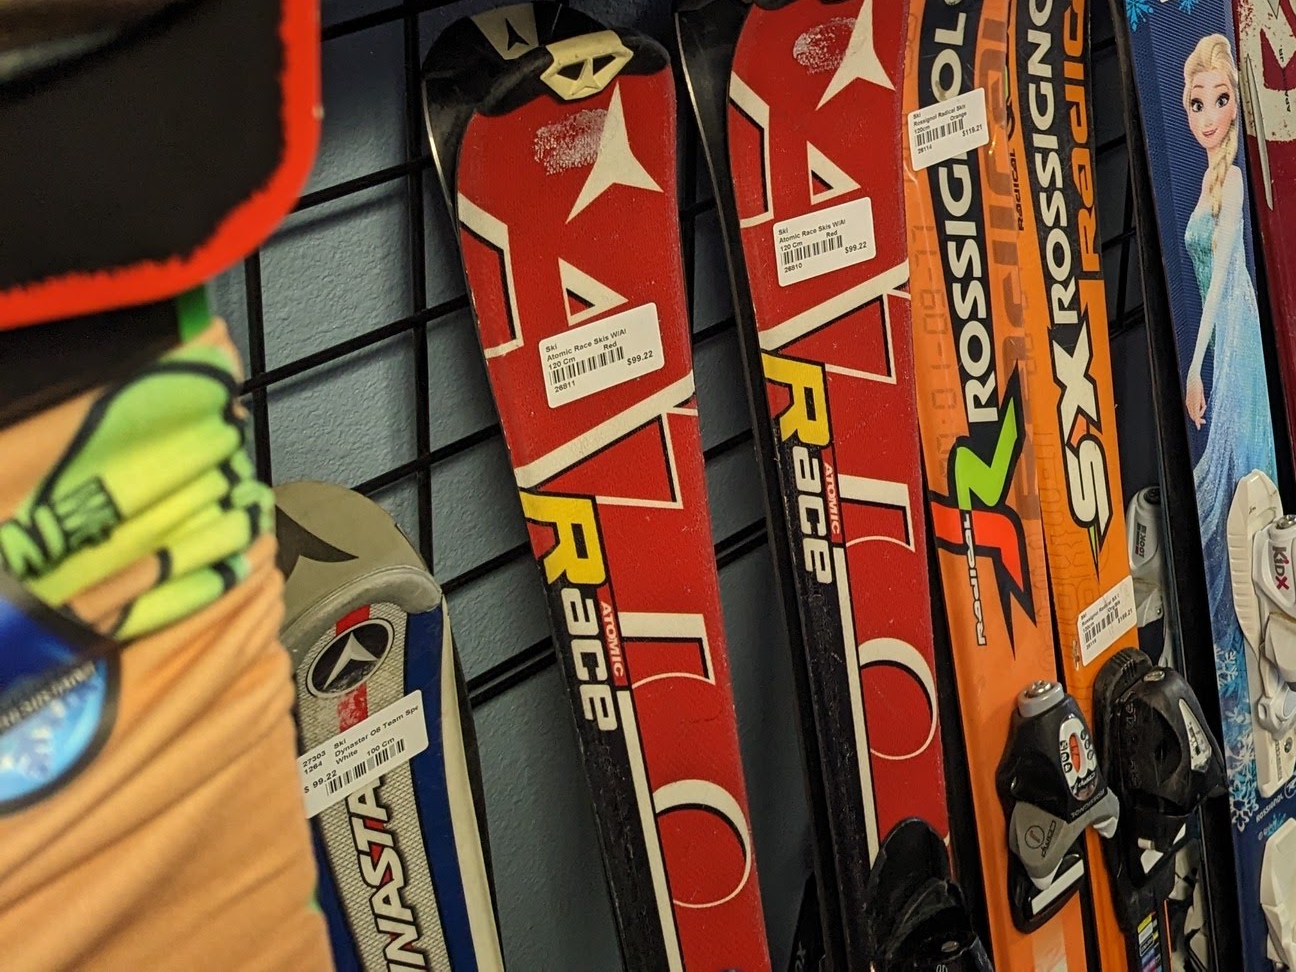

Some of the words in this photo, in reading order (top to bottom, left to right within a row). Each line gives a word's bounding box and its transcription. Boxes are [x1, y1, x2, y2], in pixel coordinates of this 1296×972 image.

[913, 115, 937, 127] Rossignol
[938, 108, 956, 118] Radical
[950, 111, 967, 122] Orange
[931, 12, 999, 423] ROSSIGOL
[778, 228, 788, 236] Ski
[779, 233, 800, 244] Atomic
[801, 228, 817, 237] Race
[818, 223, 832, 232] Skis
[780, 244, 792, 252] 120
[792, 240, 803, 248] Cm
[826, 230, 838, 238] Red
[845, 241, 867, 254] $99.22
[545, 343, 558, 353] Ski
[547, 348, 572, 362] Atomic
[574, 342, 592, 352] Race
[593, 336, 609, 345] Skis
[548, 361, 561, 370] 120
[563, 356, 576, 365] Cm
[603, 341, 618, 351] Red
[627, 350, 654, 366] $99.22
[761, 352, 833, 584] Race
[823, 462, 841, 535] ATOMIC
[519, 491, 618, 732] Race
[599, 601, 626, 678] ATOMIC
[302, 750, 326, 768] 27303
[333, 738, 347, 750] Ski
[303, 762, 323, 775] 1264
[335, 734, 368, 757] Dynastar
[383, 714, 404, 729] Team
[335, 749, 358, 764] White
[366, 745, 380, 756] 100
[382, 737, 395, 748] Cm
[312, 769, 337, 788] 99.22
[1256, 793, 1284, 823] ROSSIGNOL
